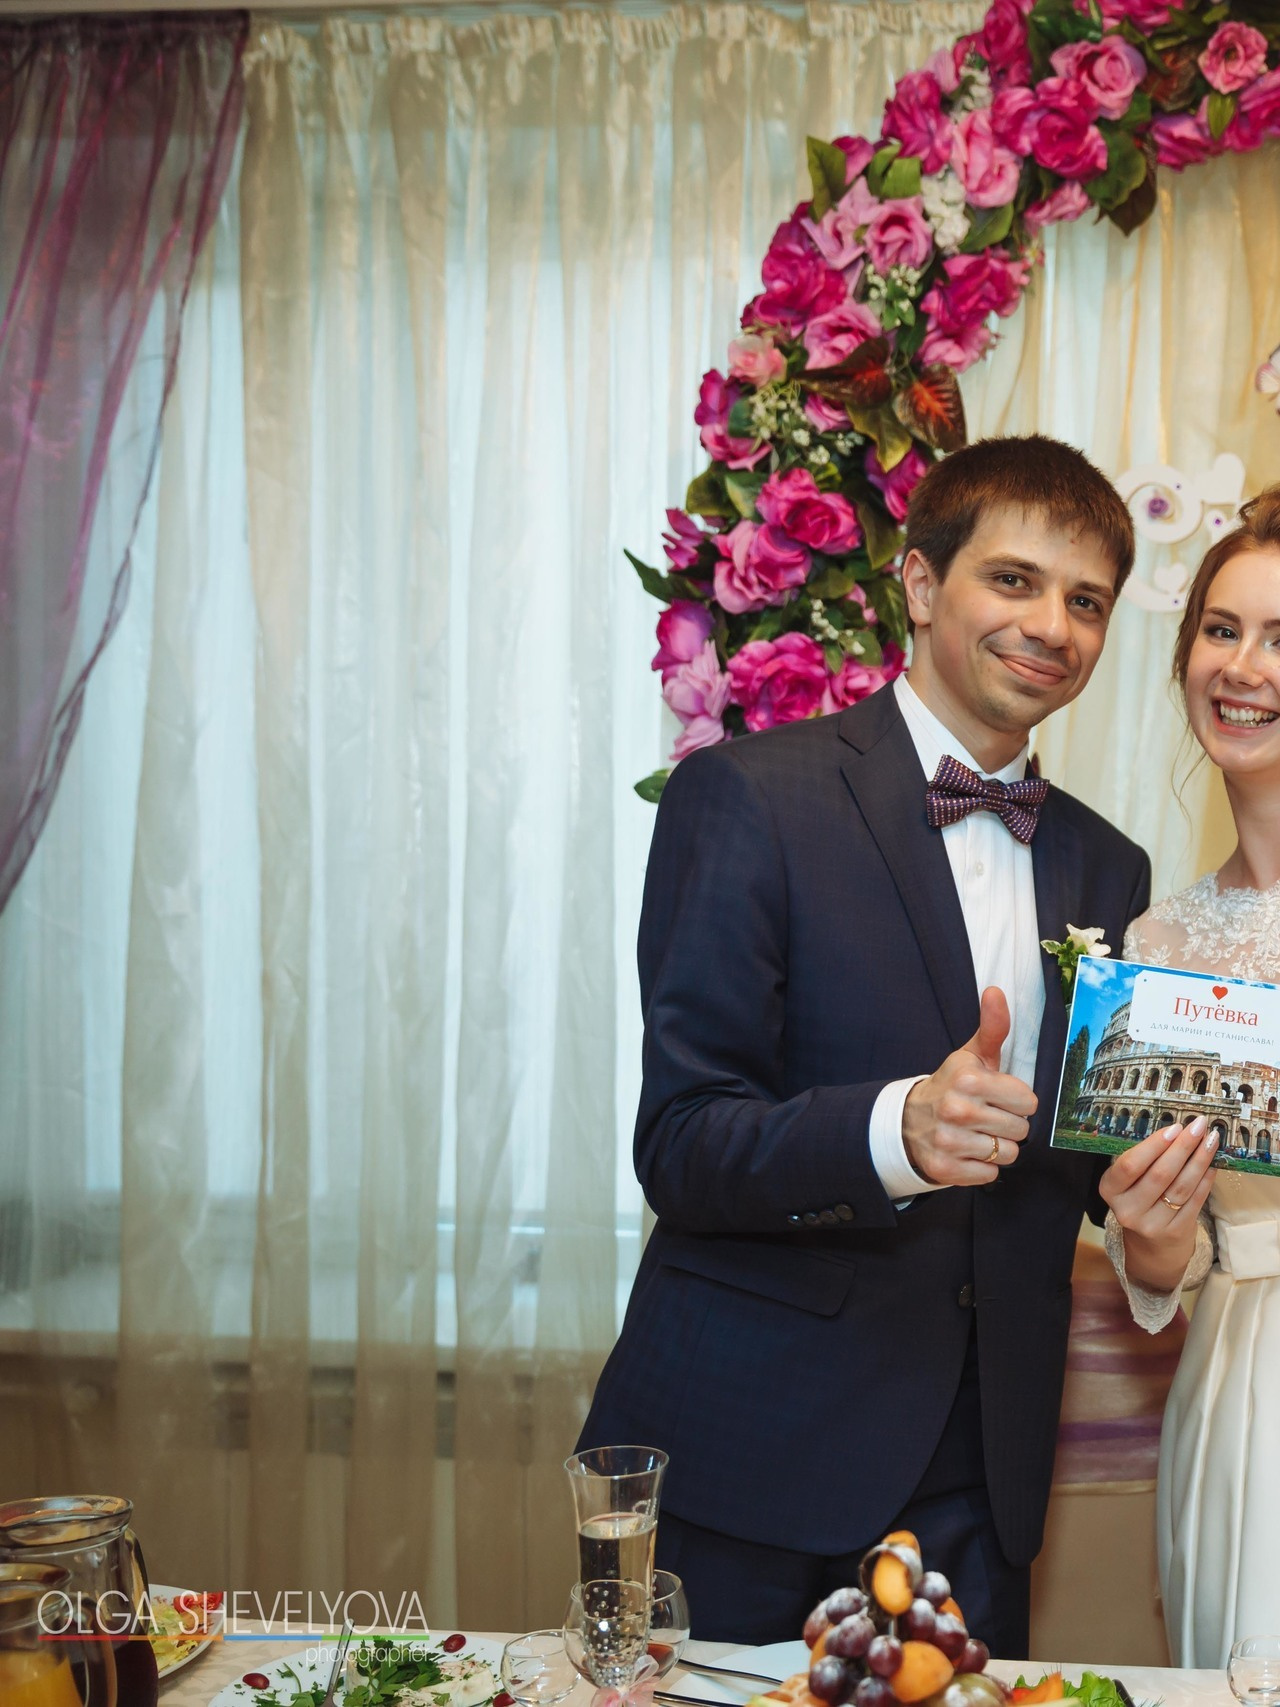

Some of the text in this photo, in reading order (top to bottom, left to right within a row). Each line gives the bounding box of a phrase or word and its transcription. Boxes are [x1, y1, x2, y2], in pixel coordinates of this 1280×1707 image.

[1173, 997, 1259, 1026] Путёвка
[1150, 1022, 1169, 1031] ДЛЯ
[1171, 1025, 1203, 1036] МАРИИ
[1214, 1031, 1275, 1046] СТАНИСЛАВА!
